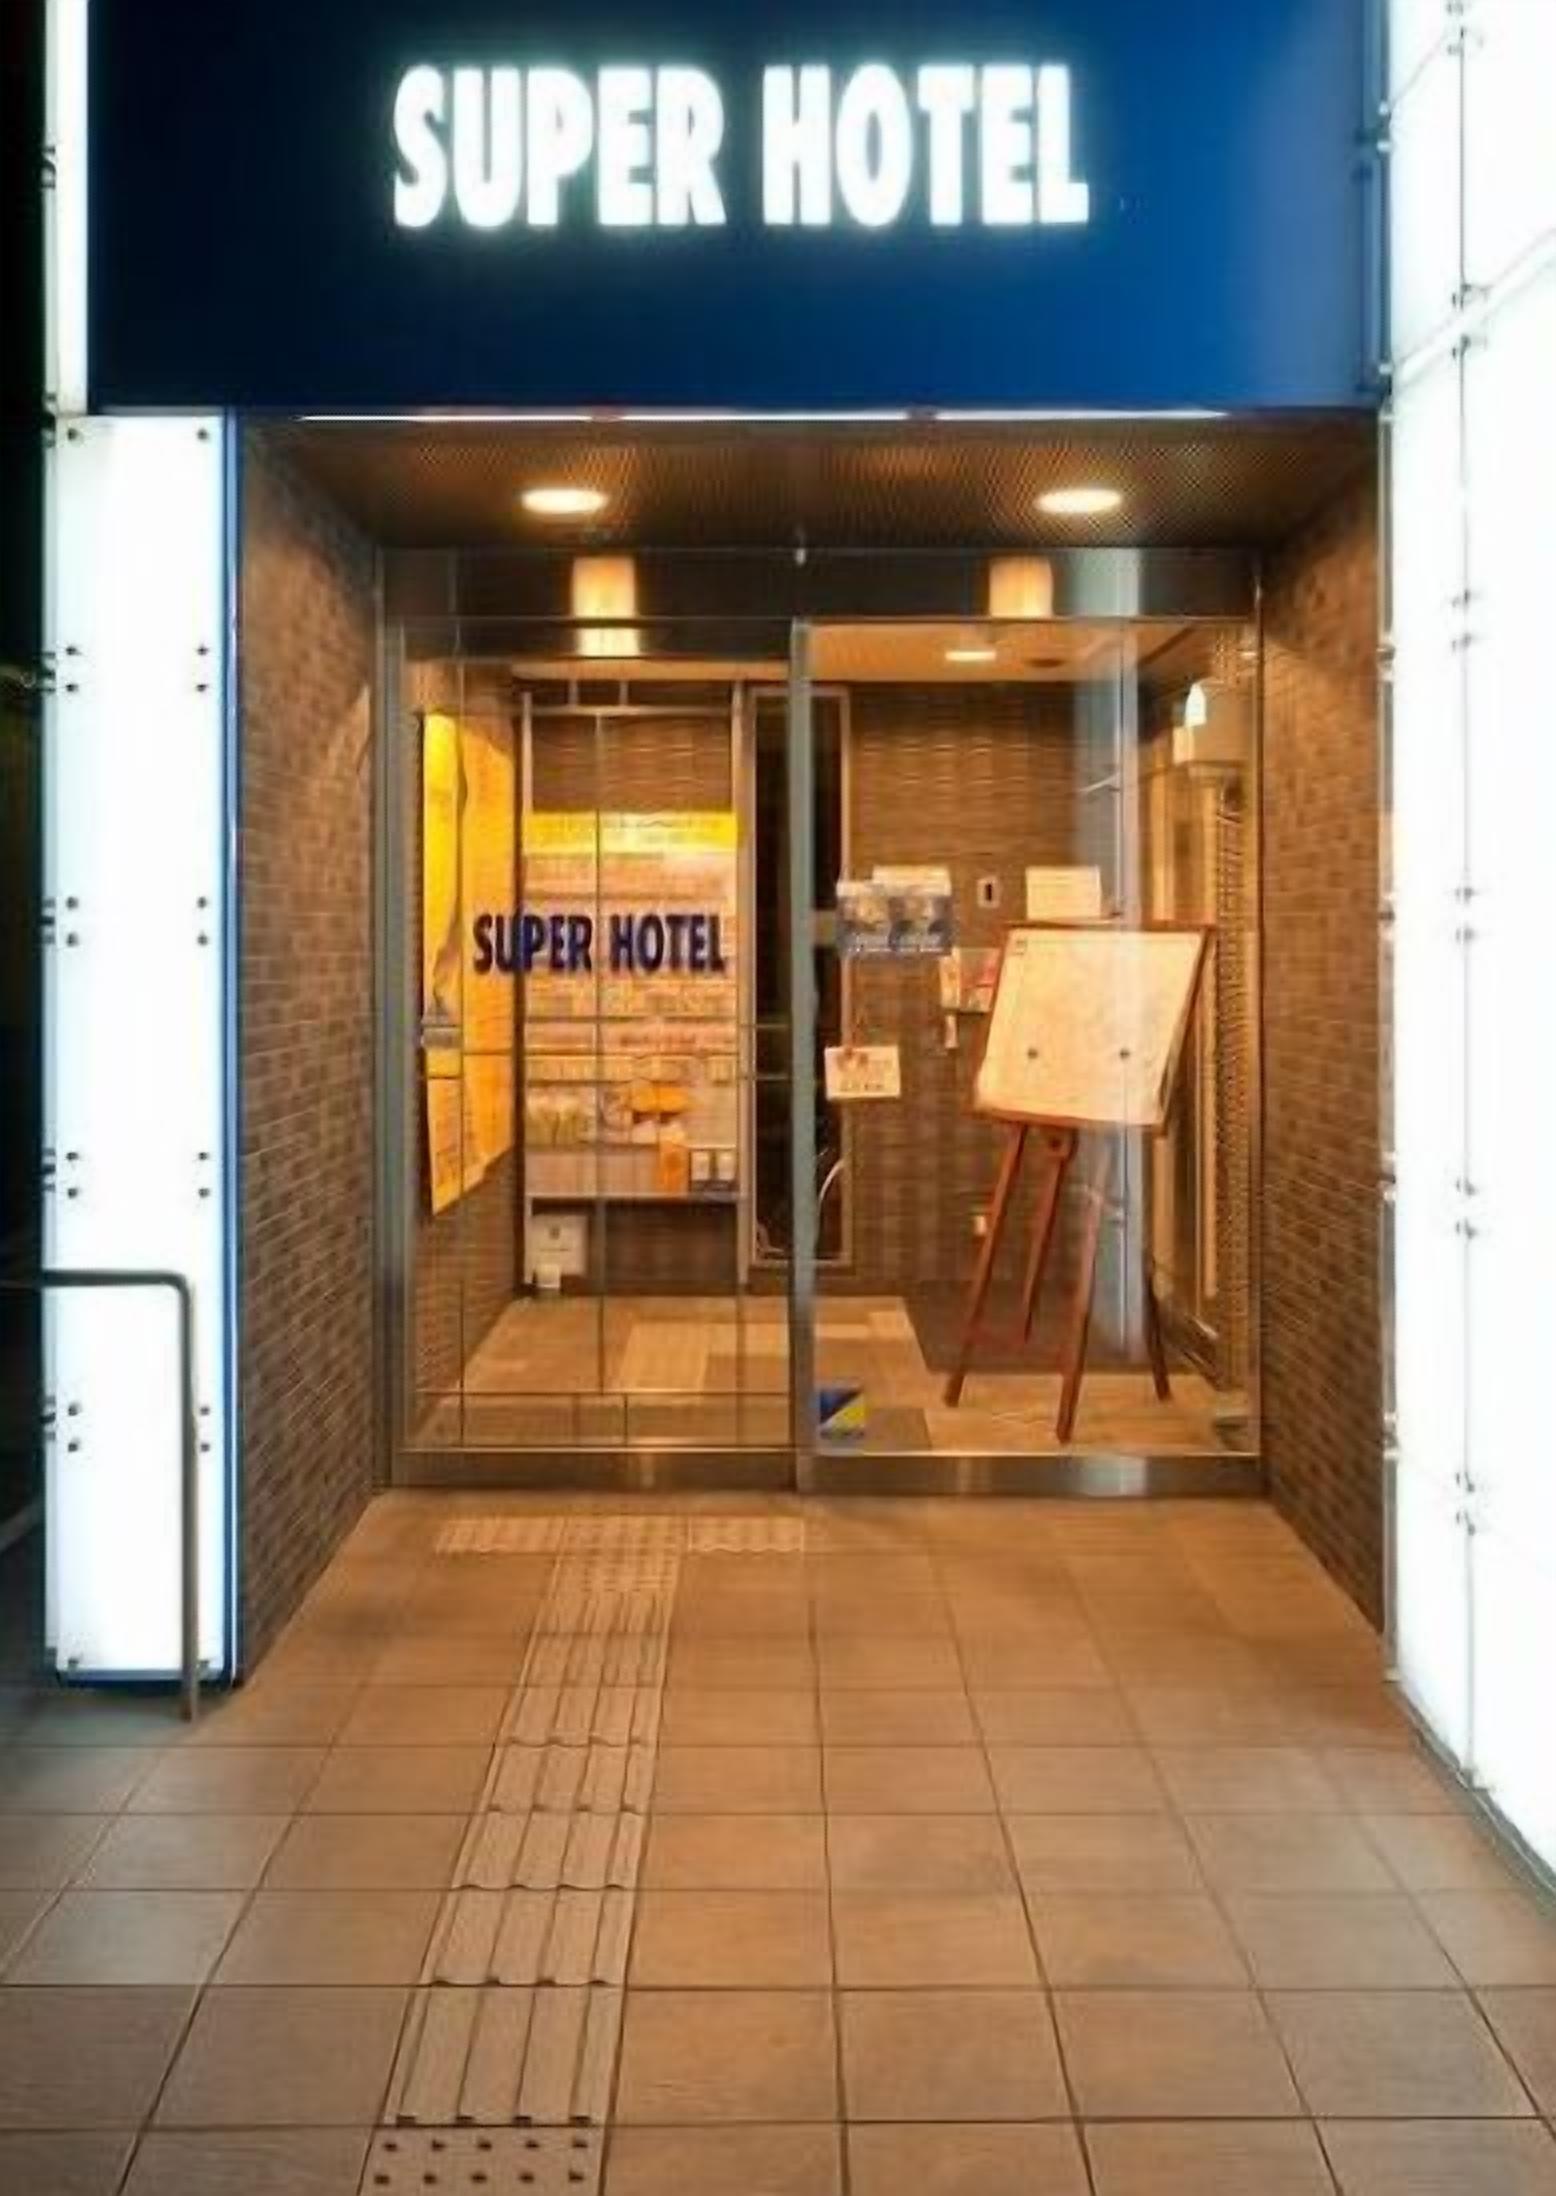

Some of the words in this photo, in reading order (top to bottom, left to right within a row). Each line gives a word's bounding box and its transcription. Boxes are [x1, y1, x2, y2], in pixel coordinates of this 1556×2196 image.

[393, 65, 725, 227] SUPER
[763, 65, 1089, 227] HOTEL
[473, 914, 593, 973] SUPER
[610, 914, 726, 973] HOTEL
